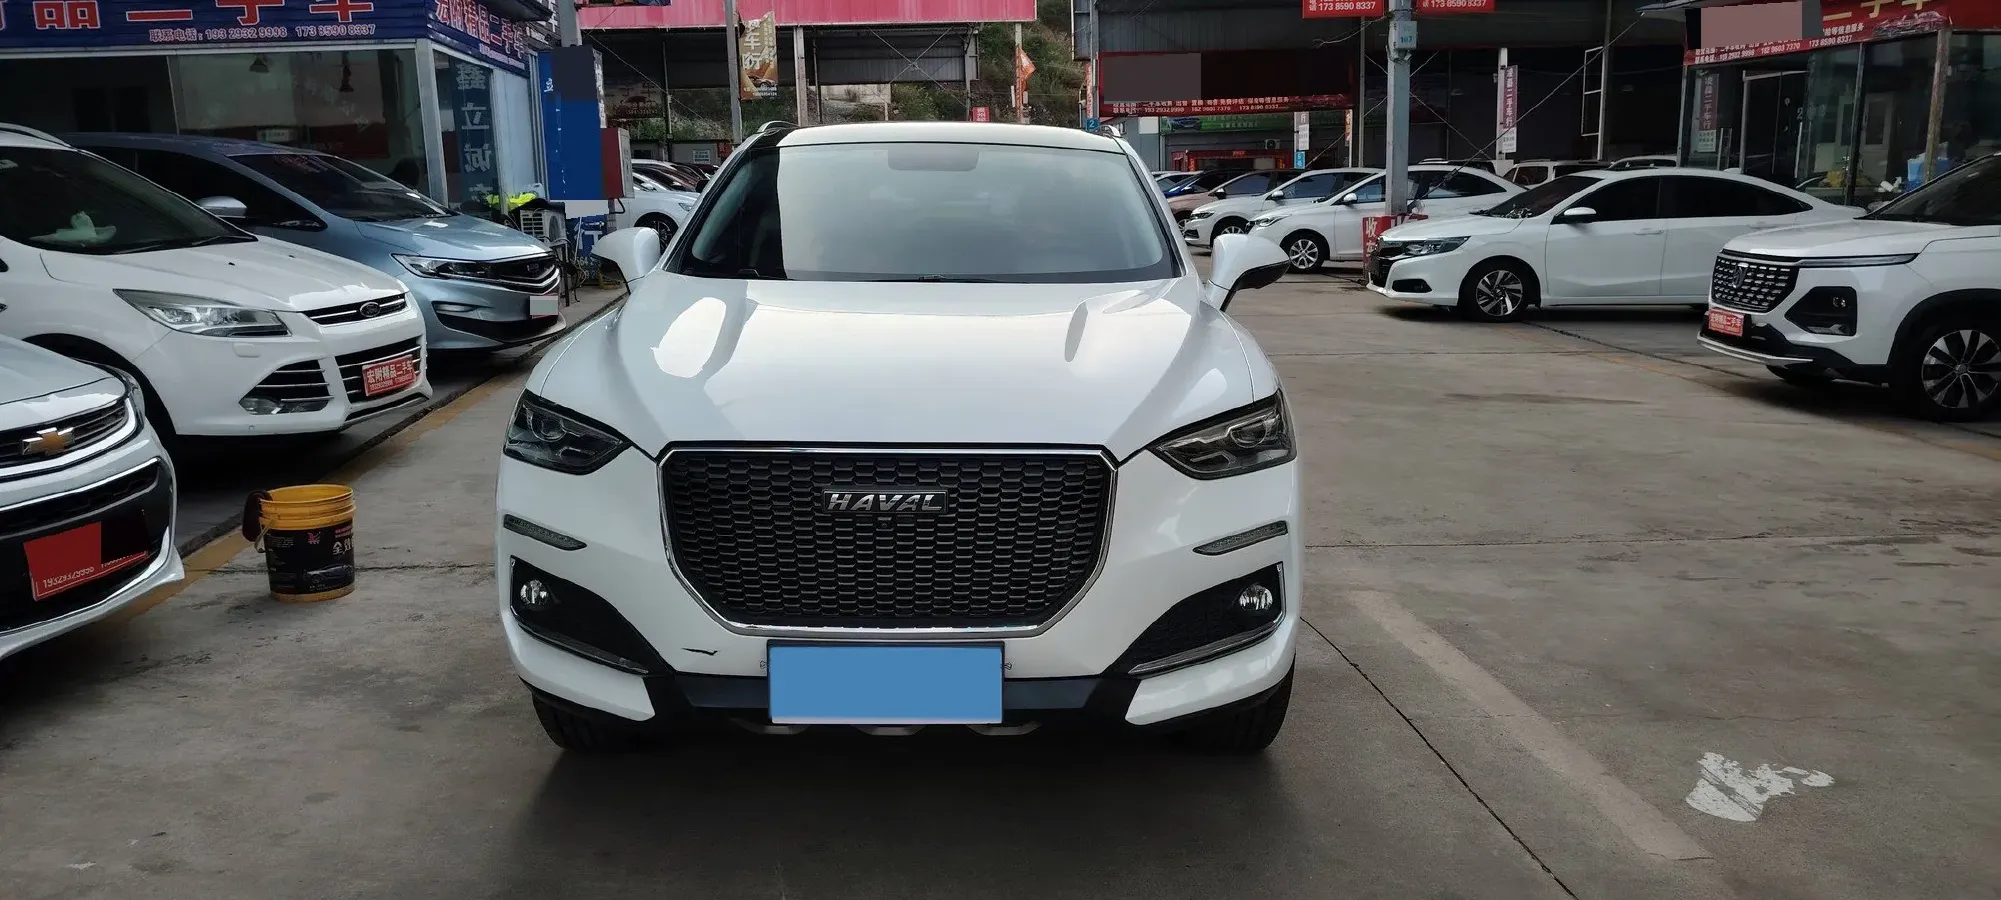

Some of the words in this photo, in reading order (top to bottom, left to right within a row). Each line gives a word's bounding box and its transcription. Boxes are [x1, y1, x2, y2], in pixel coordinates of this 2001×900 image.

[1319, 3, 1334, 11] 173
[1356, 2, 1376, 10] 8337
[228, 28, 258, 39] 2932
[827, 494, 943, 511] HAVAL
